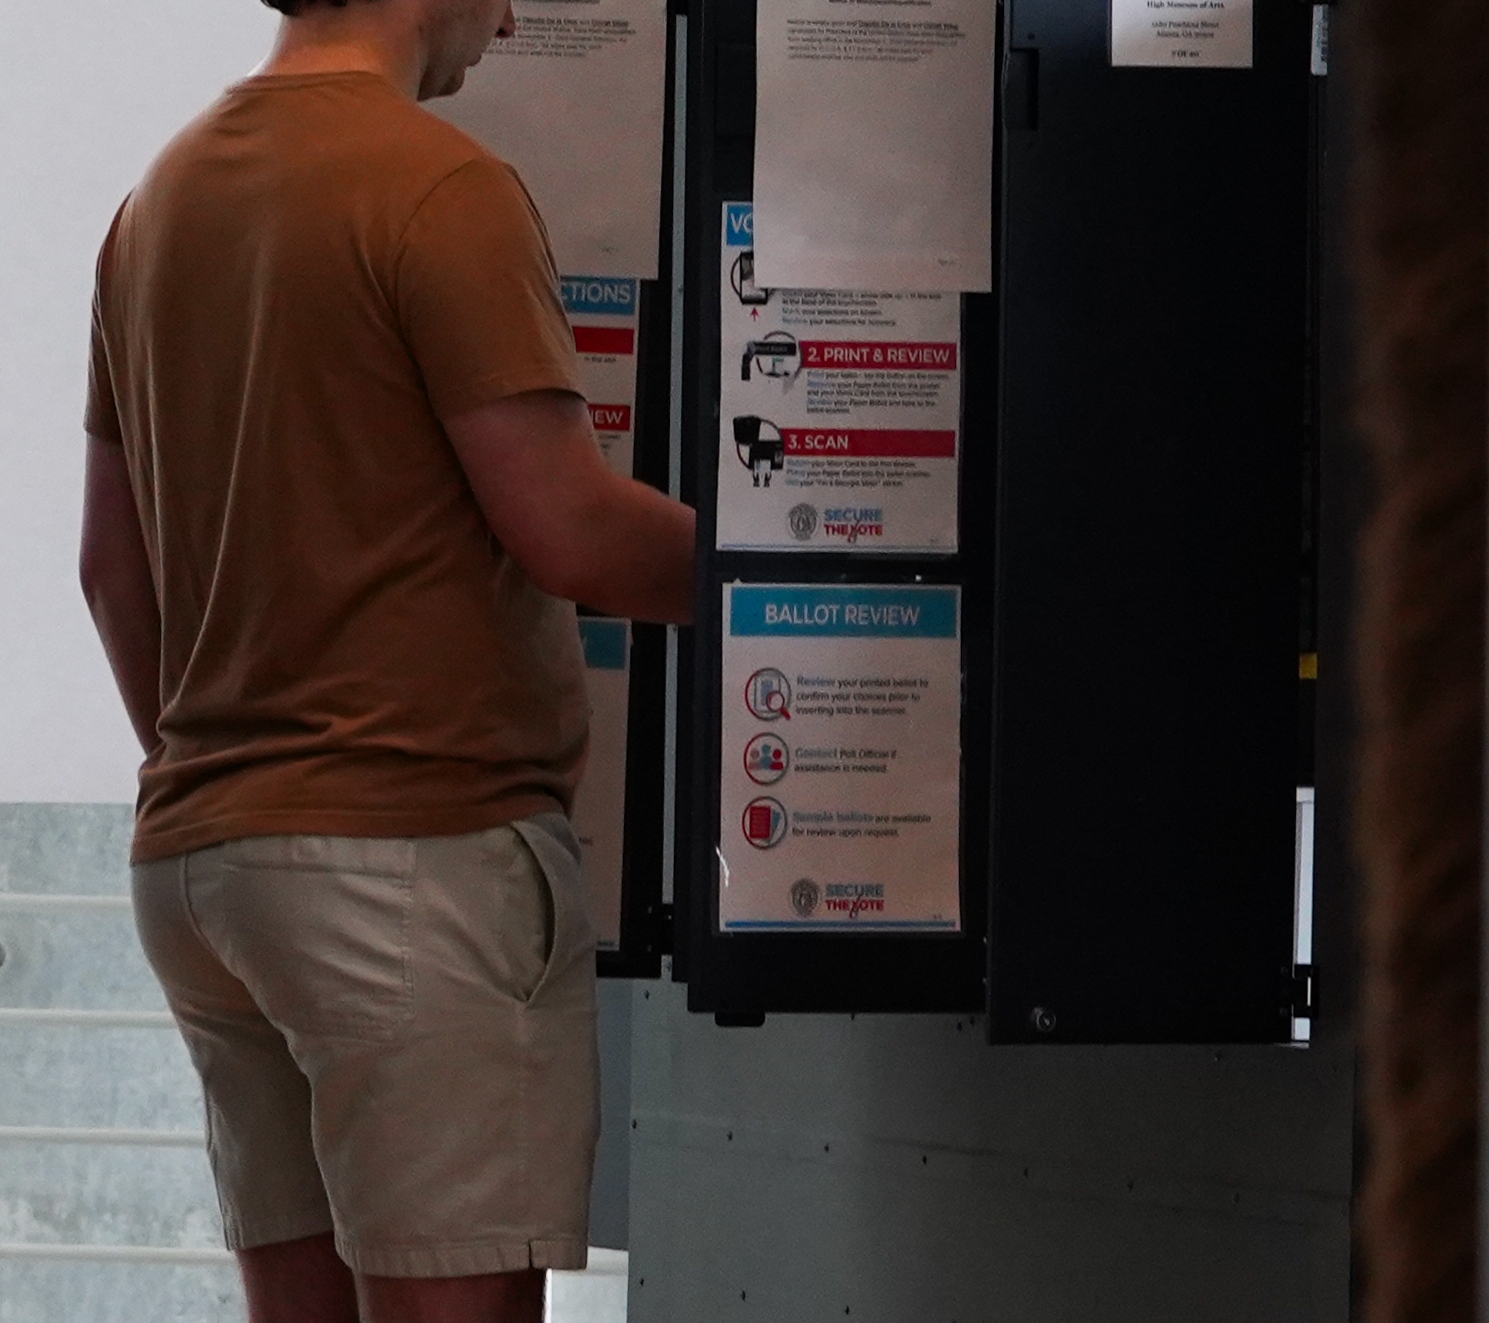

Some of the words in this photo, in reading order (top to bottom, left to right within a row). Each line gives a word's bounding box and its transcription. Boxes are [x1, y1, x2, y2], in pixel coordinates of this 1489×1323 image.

[808, 348, 820, 363] 2.
[823, 348, 870, 362] PRINT
[873, 348, 883, 362] &
[887, 348, 950, 363] REVIEW
[788, 435, 801, 449] 3.
[804, 435, 849, 450] SCAN
[824, 509, 882, 521] SECURE
[824, 524, 849, 535] THE
[765, 604, 840, 624] BALLOT
[844, 604, 920, 625] REVIEW
[825, 883, 884, 897] SECURE
[825, 899, 850, 911] THE
